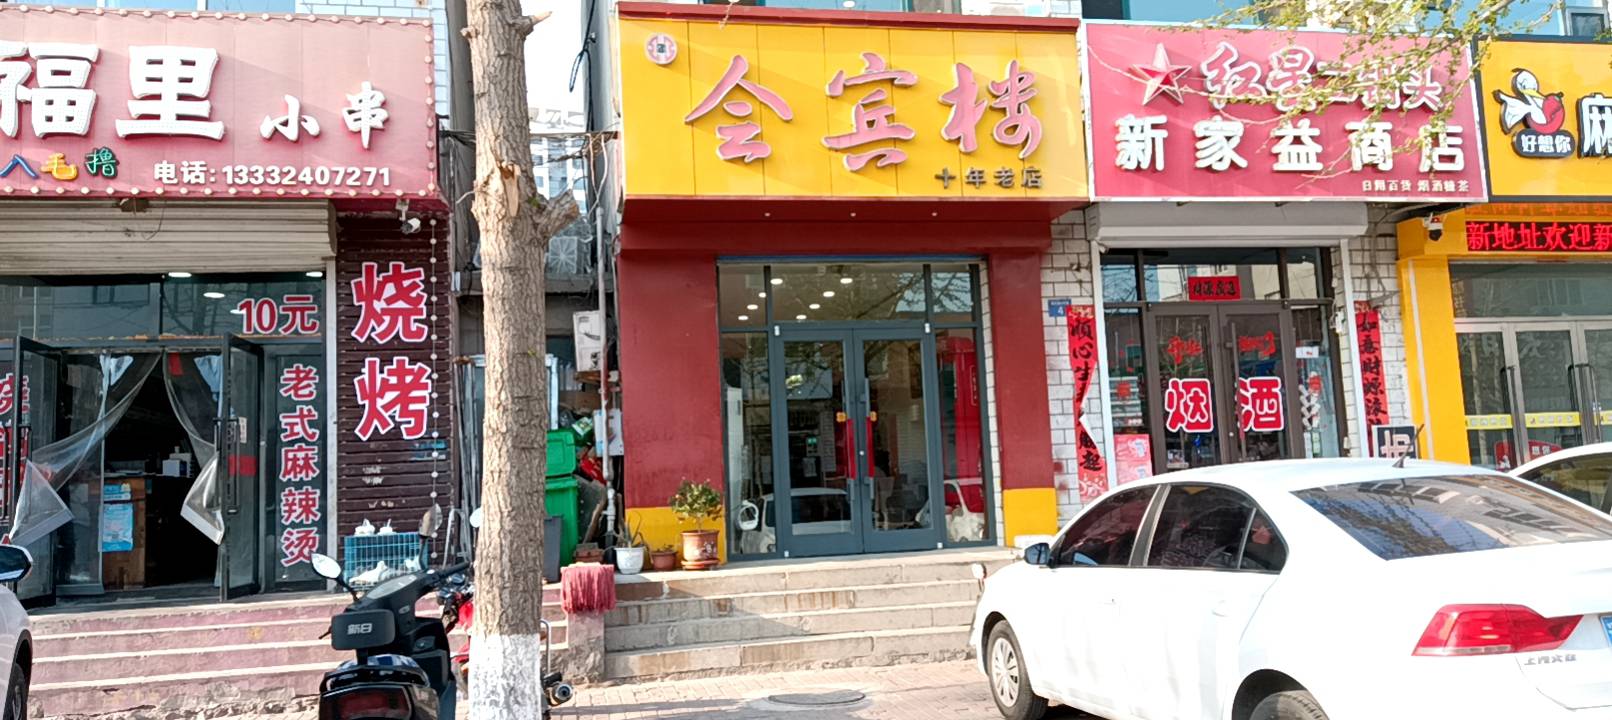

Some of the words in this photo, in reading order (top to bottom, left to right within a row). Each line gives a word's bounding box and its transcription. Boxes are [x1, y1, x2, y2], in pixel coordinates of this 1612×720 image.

[259, 81, 390, 149] 小串
[684, 52, 1043, 172] 会宾楼
[1114, 113, 1465, 173] 新家益商店
[1520, 134, 1572, 154] 好想你
[934, 167, 1043, 189] 十年老店
[1466, 222, 1612, 251] 新地址欢迎新
[237, 295, 320, 334] 10元
[351, 262, 432, 441] 烧烤
[280, 364, 321, 568] 老式麻辣烫
